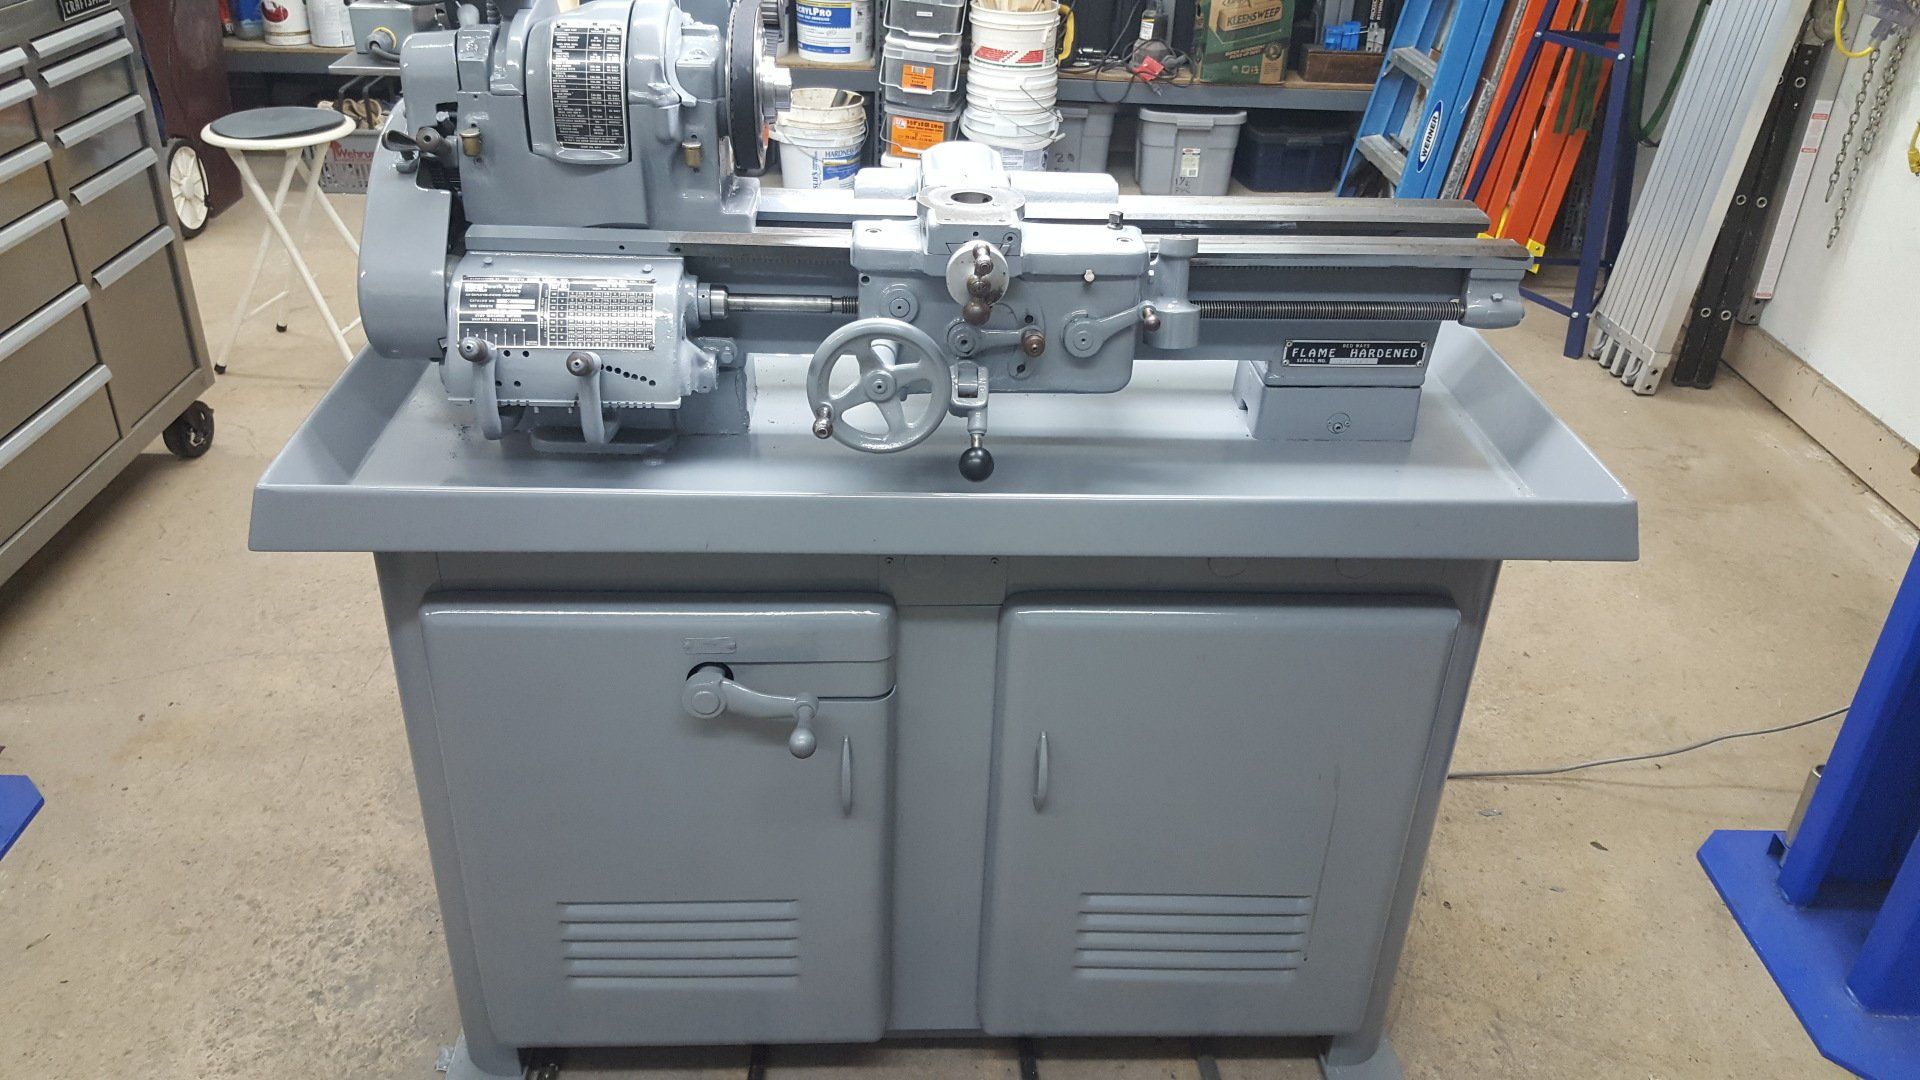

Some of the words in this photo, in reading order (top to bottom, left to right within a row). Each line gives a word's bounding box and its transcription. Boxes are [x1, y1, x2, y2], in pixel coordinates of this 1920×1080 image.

[65, 0, 107, 14] CRAFTS
[1420, 115, 1439, 158] WERNER
[1291, 348, 1337, 358] FLAME
[1349, 348, 1418, 358] HARDENED
